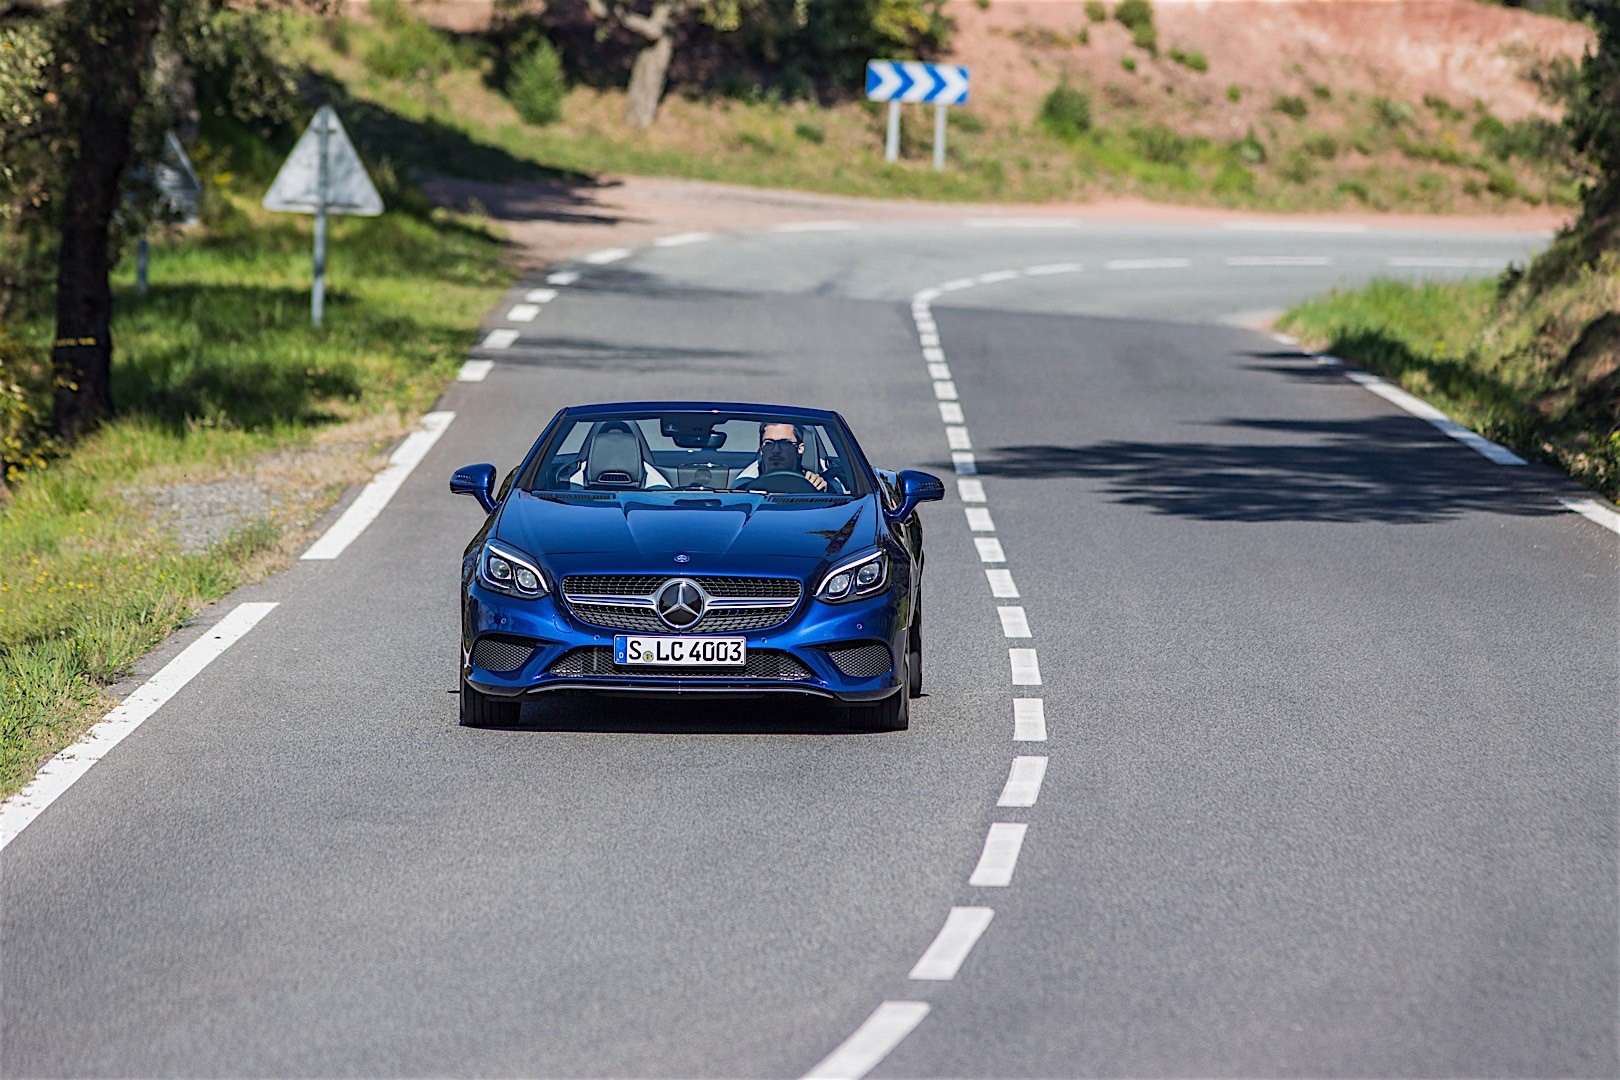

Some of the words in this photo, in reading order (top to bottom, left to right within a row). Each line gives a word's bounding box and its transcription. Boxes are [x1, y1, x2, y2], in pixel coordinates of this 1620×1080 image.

[628, 640, 642, 660] S
[656, 641, 684, 661] LC
[689, 641, 742, 662] 4003
